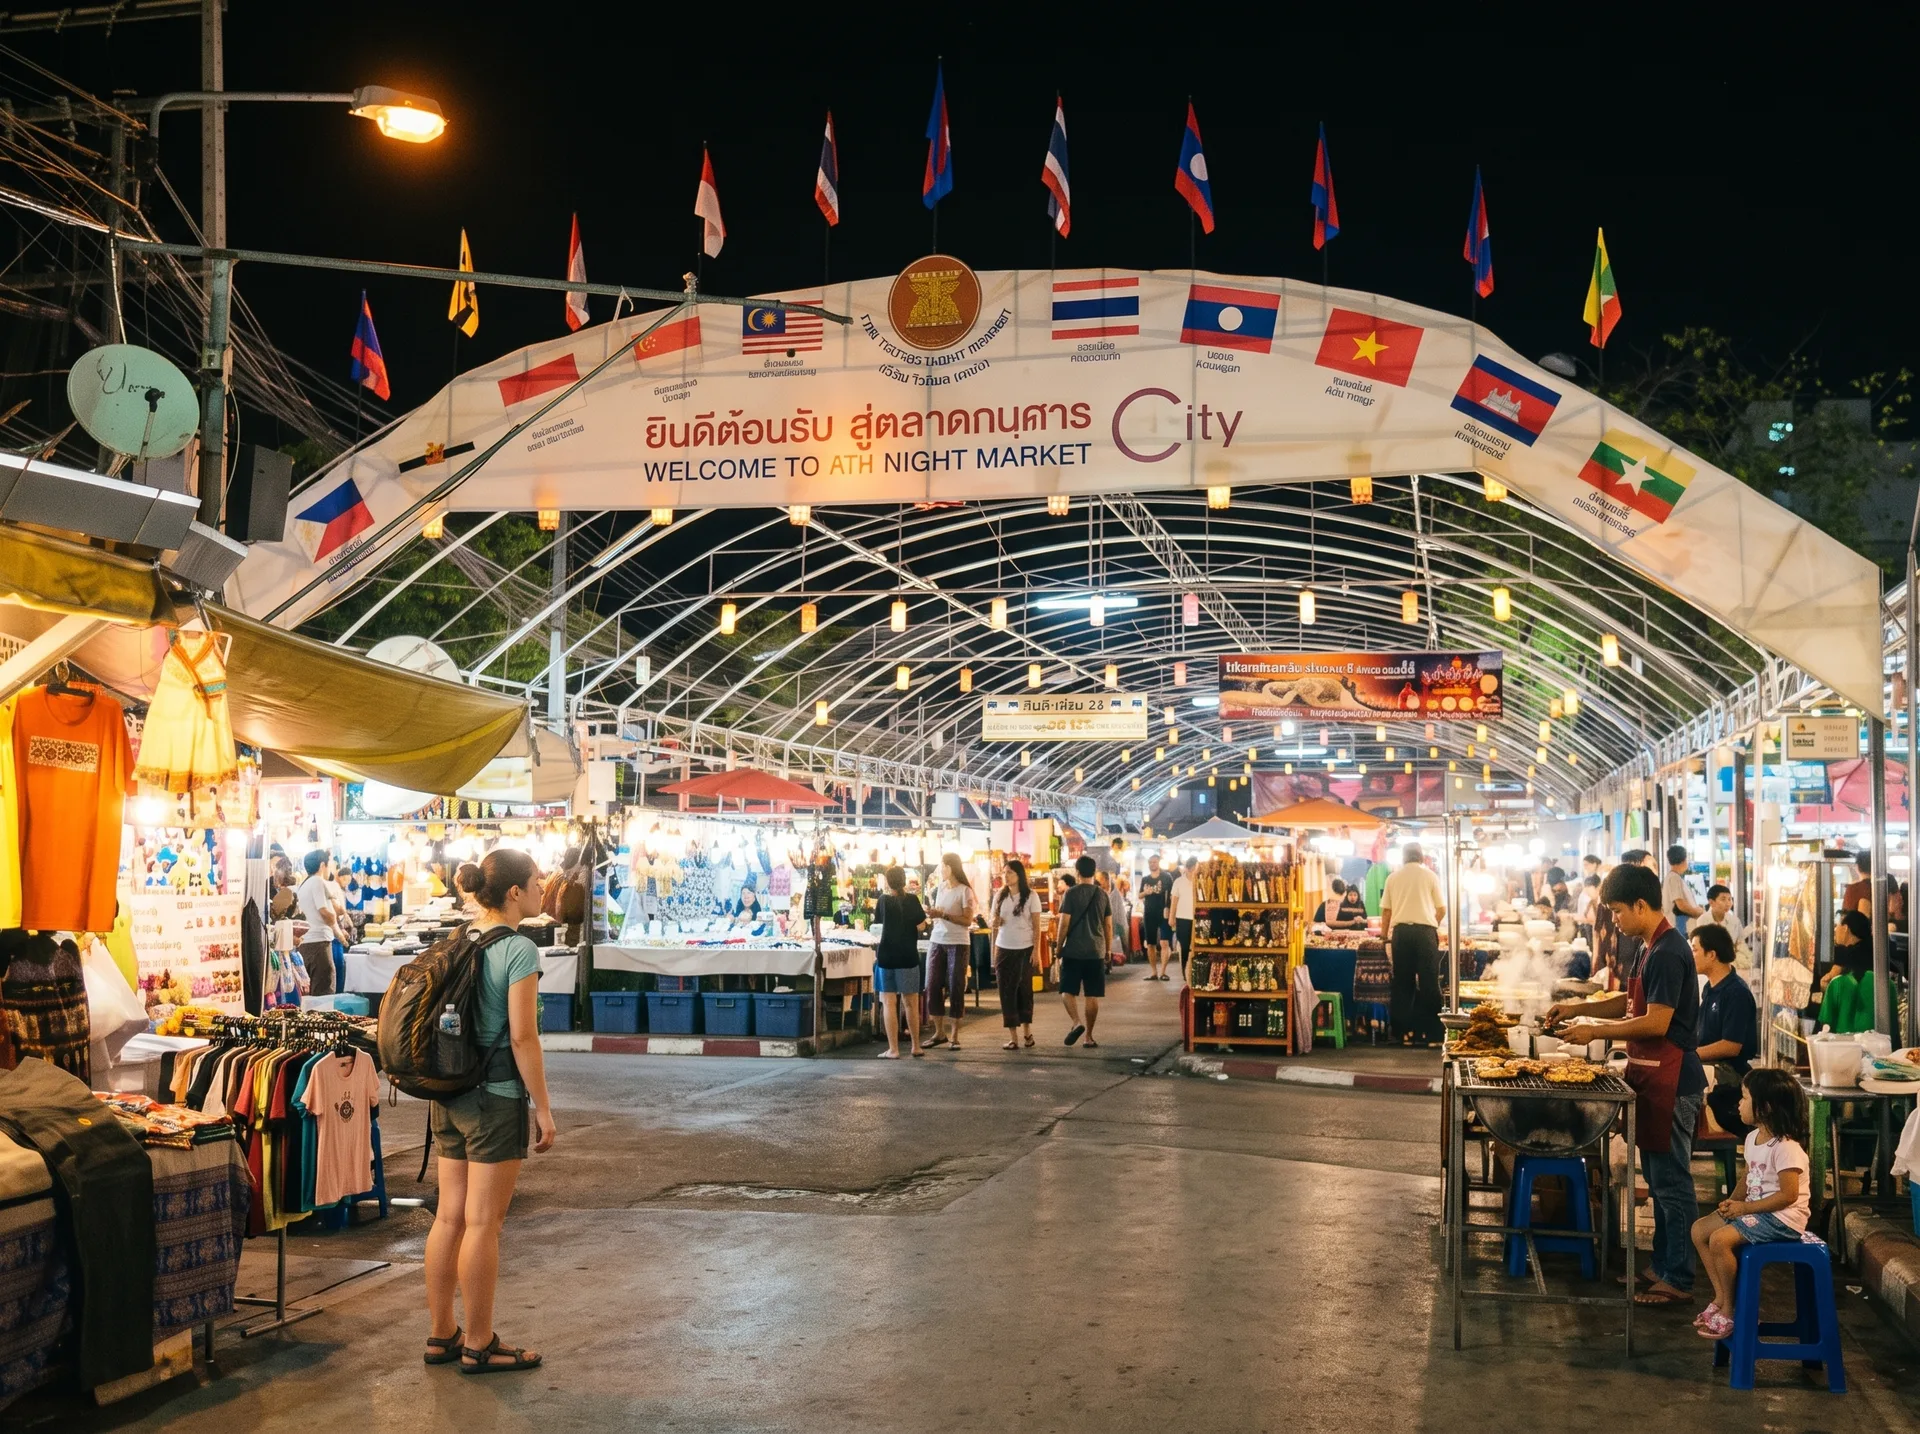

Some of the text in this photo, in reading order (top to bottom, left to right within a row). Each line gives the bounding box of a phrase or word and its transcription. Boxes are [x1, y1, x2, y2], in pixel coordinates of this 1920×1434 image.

[646, 408, 833, 449] ยินดีต้อนรับ
[1112, 388, 1243, 463] City
[644, 443, 1092, 482] WELCOME TO ATH NIGHT MARKET
